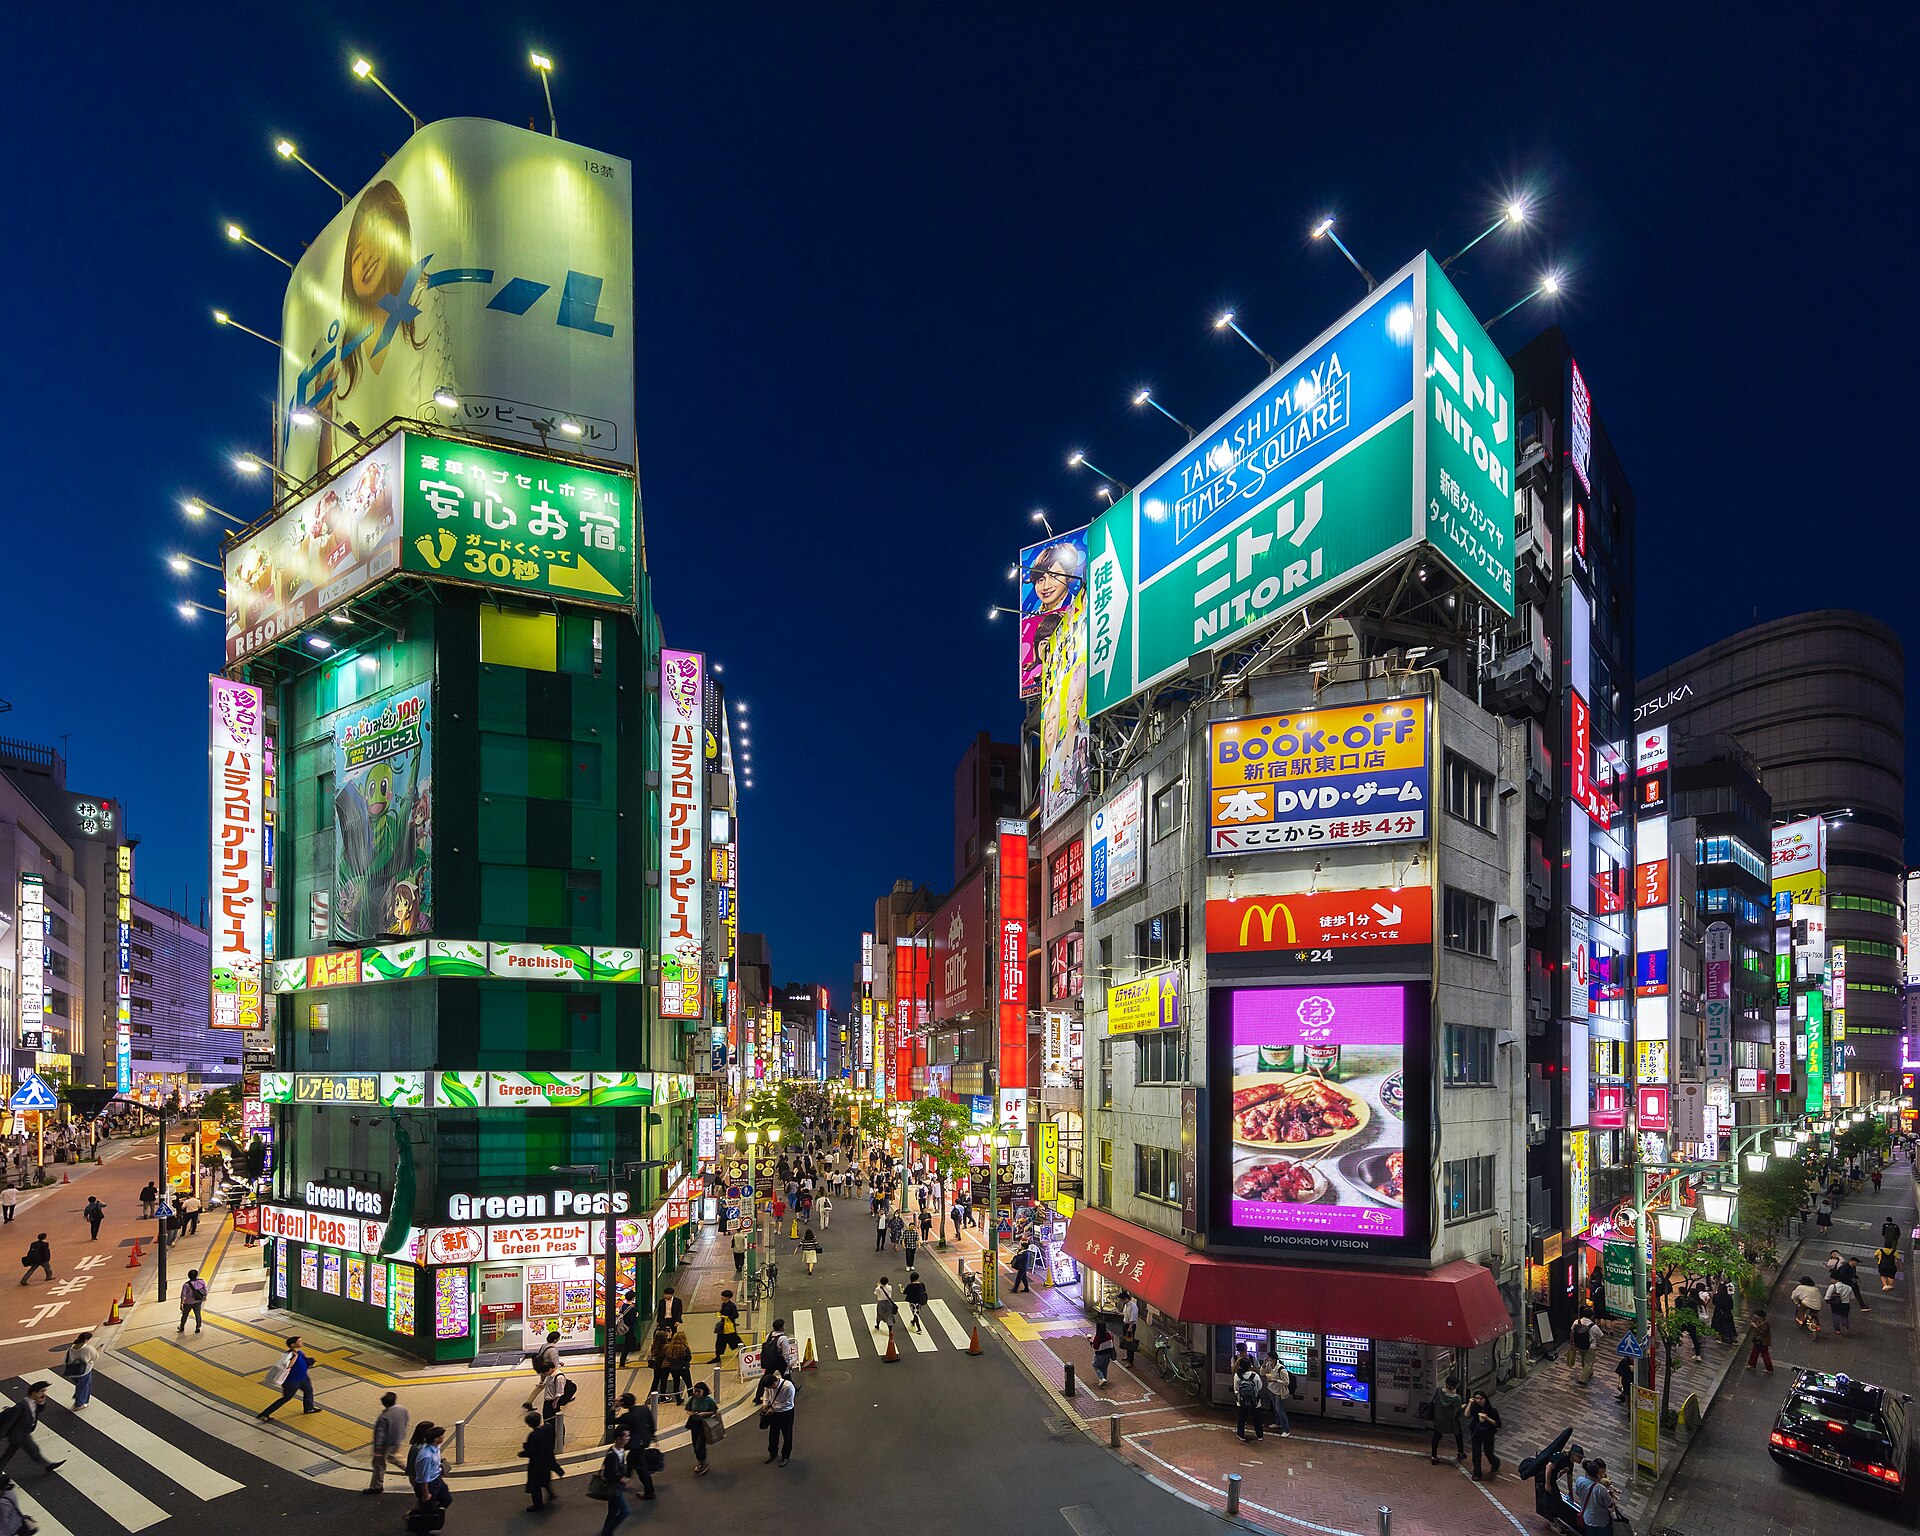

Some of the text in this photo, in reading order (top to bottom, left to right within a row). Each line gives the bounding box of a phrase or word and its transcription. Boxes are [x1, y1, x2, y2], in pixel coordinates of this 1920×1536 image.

[583, 159, 615, 180] 18禁
[1434, 308, 1509, 445] ニトリ
[452, 401, 602, 441] ハッピーメル
[1180, 351, 1344, 495] TAKASHIMAYA
[1180, 384, 1344, 530] TIMES SQUARE
[1435, 386, 1509, 499] NITORI
[421, 454, 620, 507] 豪華カプセルホテル
[419, 479, 621, 552] 安心お宿
[1439, 467, 1504, 551] 新宿タカシマヤ
[465, 533, 571, 564] ガードくぐって
[1194, 480, 1324, 608] ニトリ
[1430, 497, 1512, 596] タイムズスクエア店
[464, 550, 541, 581] 30秒
[1193, 547, 1323, 645] NITORI
[235, 600, 306, 657] RESORTS
[1094, 560, 1114, 667] 徒歩2分
[397, 697, 420, 721] 100
[365, 729, 415, 759] グリンピース
[1576, 702, 1586, 798] アイフル
[1244, 750, 1386, 781] 新宿駅東口店
[1646, 763, 1660, 773] 9F
[1218, 789, 1268, 822] 本
[1277, 781, 1423, 814] DVD・ゲーム
[1640, 801, 1655, 810] Gong
[669, 724, 697, 939] パチスログリンピース
[1245, 816, 1417, 846] ここから徒歩4分
[221, 750, 256, 955] パチスログリンピース
[1645, 863, 1660, 905] アイフル
[1319, 911, 1371, 928] 徒歩1分
[1321, 930, 1400, 942] ガードくぐって左
[508, 955, 574, 970] Pachislo
[944, 947, 968, 995] GAME
[1009, 935, 1023, 1001] GAME
[1310, 949, 1334, 963] 24
[1646, 986, 1658, 994] 4F
[1708, 962, 1721, 999] Serina
[1648, 1042, 1658, 1076] おたからや
[1779, 1040, 1788, 1070] docomo
[298, 1077, 376, 1101] レア台の聖地
[499, 1084, 581, 1097] Green Peas
[1005, 1101, 1022, 1112] 6F
[305, 1181, 383, 1216] Green Peas
[449, 1189, 630, 1221] Green Peas
[262, 1206, 304, 1239] Green
[308, 1213, 346, 1247] Peas
[366, 1224, 379, 1243] 新
[441, 1228, 469, 1253] 新
[492, 1226, 586, 1244] 選べるスロット
[1263, 1235, 1369, 1250] MONOKROM VISION
[501, 1241, 578, 1256] Green Peas
[1085, 1239, 1147, 1283] 食堂 長野屋
[445, 1268, 461, 1278] 1F
[438, 1278, 453, 1328] ジャグラー
[453, 1277, 468, 1321] まるごと
[607, 1327, 615, 1366] SHINJUKU
